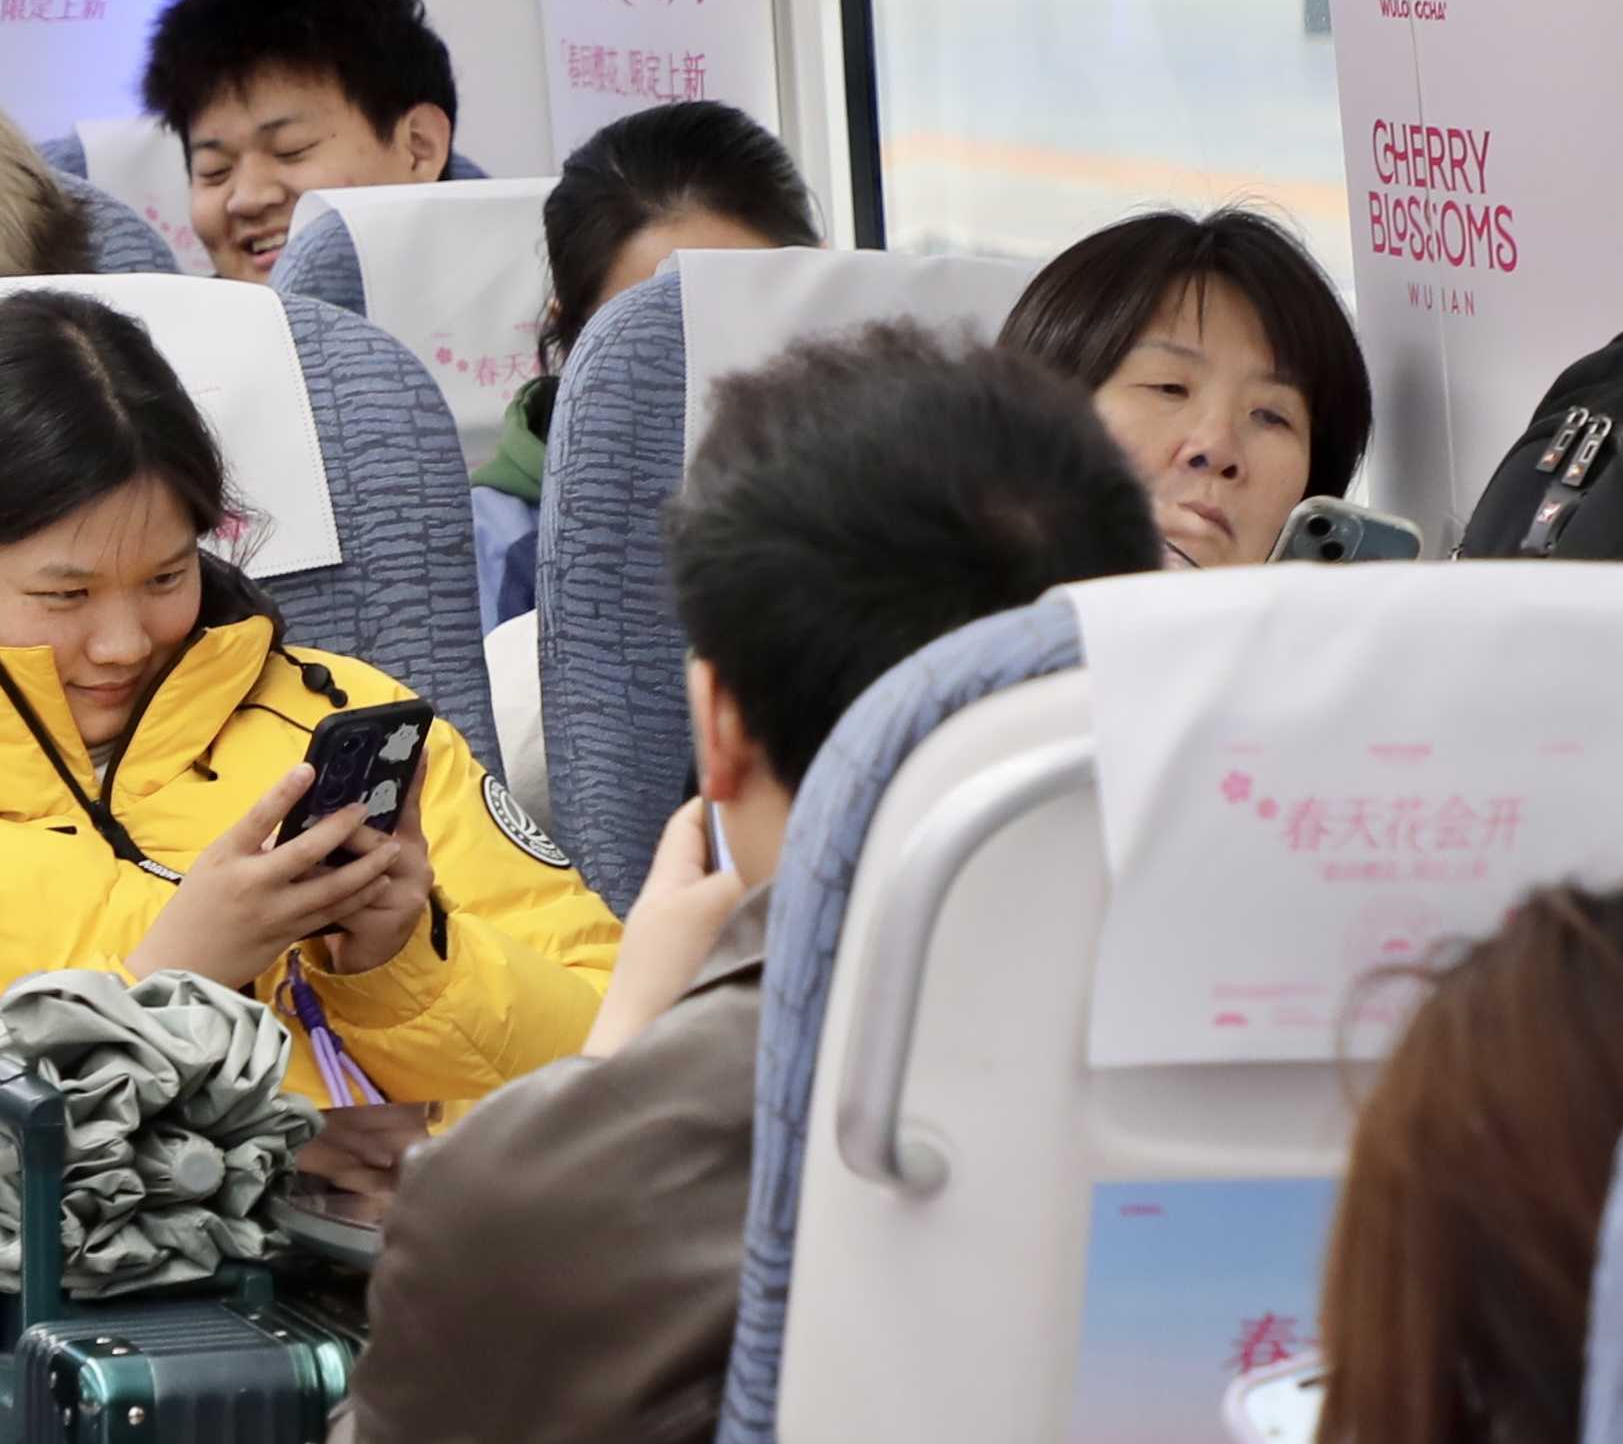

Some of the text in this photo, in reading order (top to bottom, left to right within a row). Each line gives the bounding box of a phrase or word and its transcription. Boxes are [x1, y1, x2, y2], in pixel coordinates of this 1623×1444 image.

[1372, 117, 1491, 196] CHERRY
[1368, 190, 1519, 274] BLOSSOMS
[1278, 794, 1529, 853] 春天花会开
